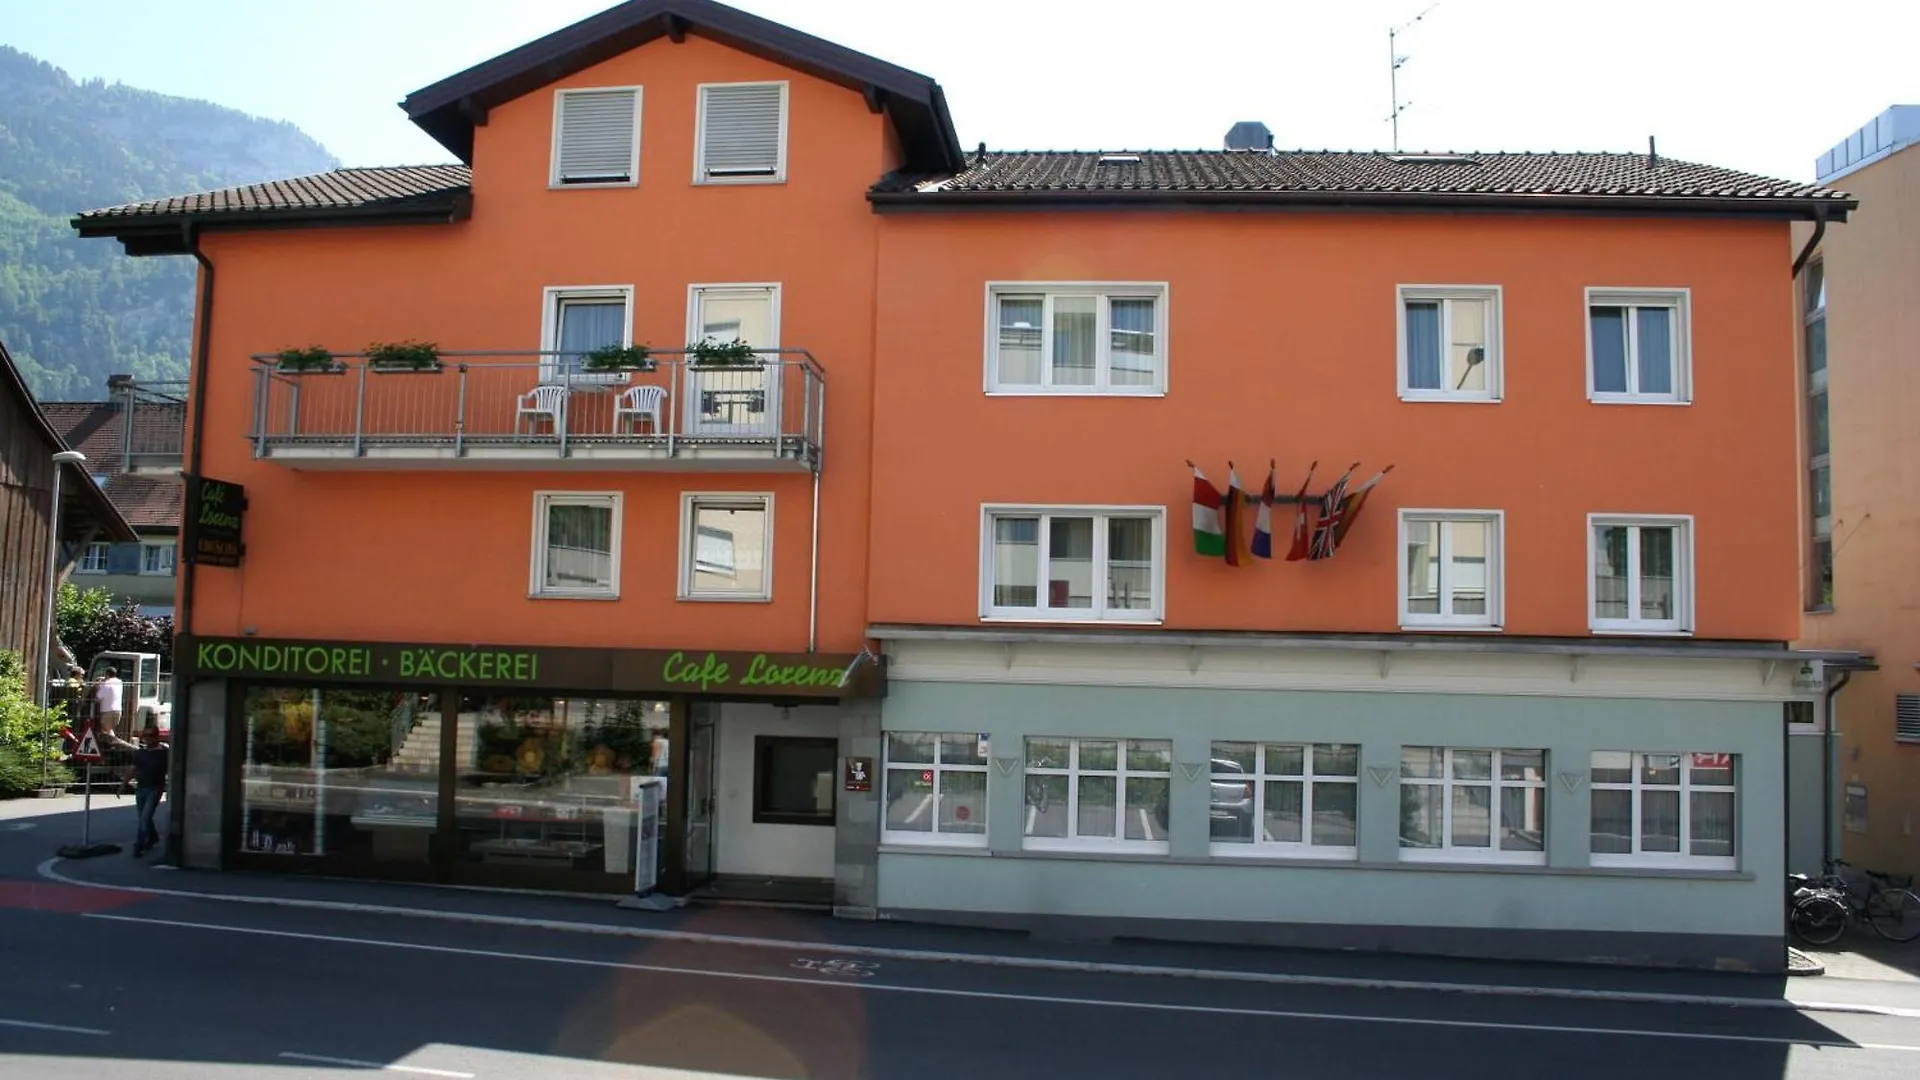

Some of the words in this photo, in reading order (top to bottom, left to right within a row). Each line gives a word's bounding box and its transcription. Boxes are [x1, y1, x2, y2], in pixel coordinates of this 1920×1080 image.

[197, 643, 371, 676] KONDITOREI
[398, 648, 538, 681] BÄCKEREI
[663, 651, 730, 690] Cafe
[739, 653, 850, 687] Lorenz
